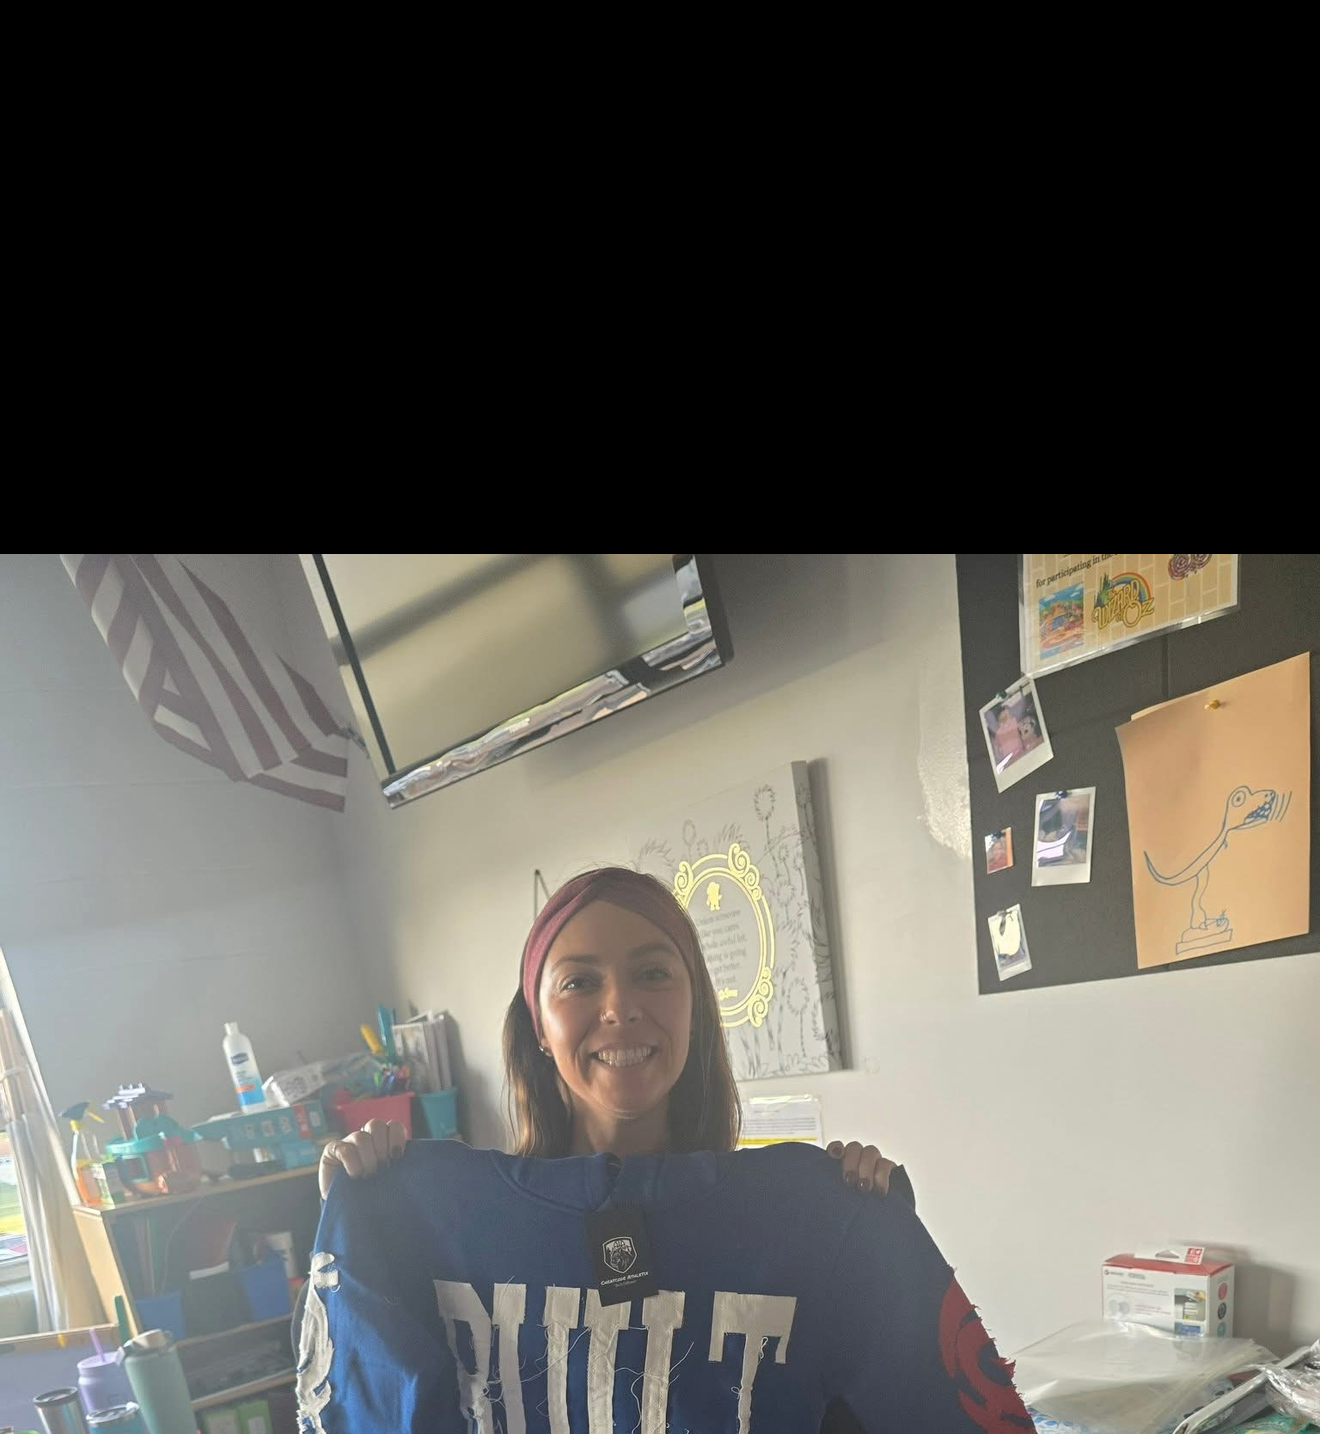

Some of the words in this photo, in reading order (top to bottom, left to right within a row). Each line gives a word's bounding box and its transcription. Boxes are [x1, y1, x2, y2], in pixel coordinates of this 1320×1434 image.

[1036, 578, 1047, 588] for
[1047, 560, 1092, 585] participating
[1092, 556, 1101, 565] in
